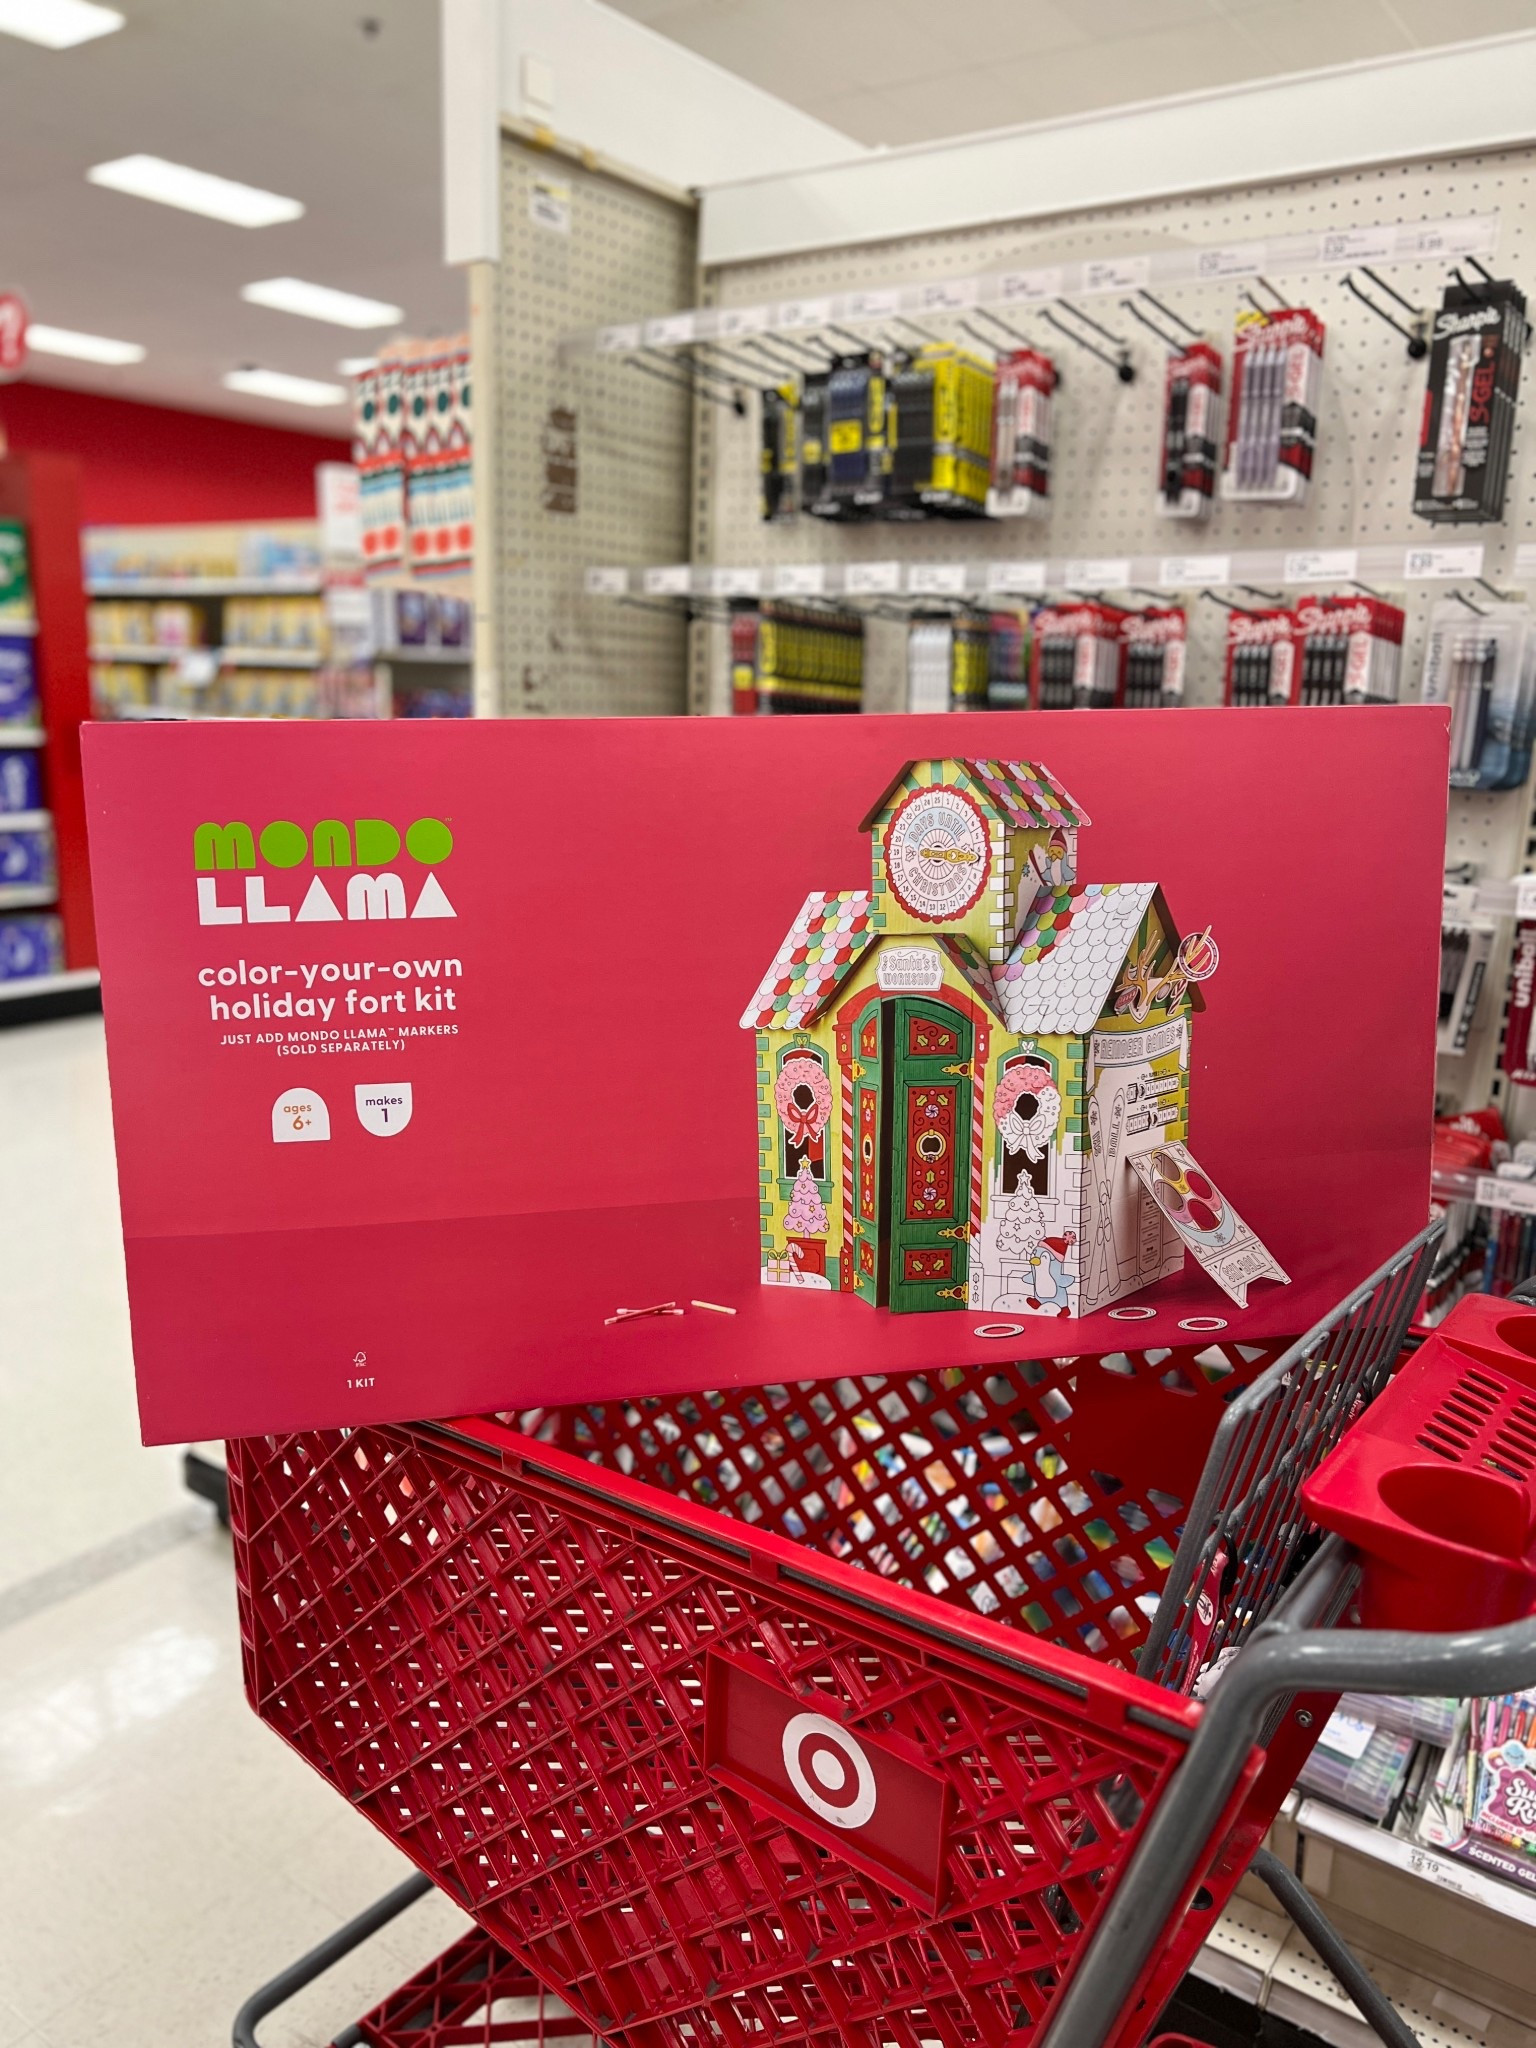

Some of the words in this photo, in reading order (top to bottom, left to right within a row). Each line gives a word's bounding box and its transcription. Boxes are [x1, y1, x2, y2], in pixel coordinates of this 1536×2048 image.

[1432, 306, 1501, 340] Sharpie
[908, 813, 934, 842] DAYS
[938, 812, 965, 842] UNTIL
[194, 817, 453, 870] MONDO
[908, 865, 968, 896] CHRISTMAS
[196, 871, 458, 926] LLAMA
[198, 958, 462, 989] color-your-own
[889, 954, 930, 972] Santa's
[1514, 929, 1535, 1008] uniball
[883, 972, 936, 986] WORKSHOP
[210, 992, 336, 1022] holiday
[345, 988, 406, 1014] fort
[414, 986, 457, 1012] kit
[220, 1034, 252, 1045] JUST
[256, 1032, 284, 1044] ADD
[288, 1030, 340, 1042] MONDO
[398, 1024, 458, 1036] MARKERS
[277, 1044, 316, 1056] (SOLD
[320, 1039, 405, 1053] SEPARATELY)
[1100, 1037, 1143, 1060] REINDEER
[1146, 1025, 1175, 1054] GAMES
[283, 1104, 312, 1114] ages
[366, 1096, 402, 1106] makes
[292, 1116, 312, 1130] 6+
[382, 1108, 388, 1122] 1
[346, 1380, 352, 1388] 1
[356, 1378, 375, 1388] KIT
[1468, 1846, 1516, 1873] SCENTED
